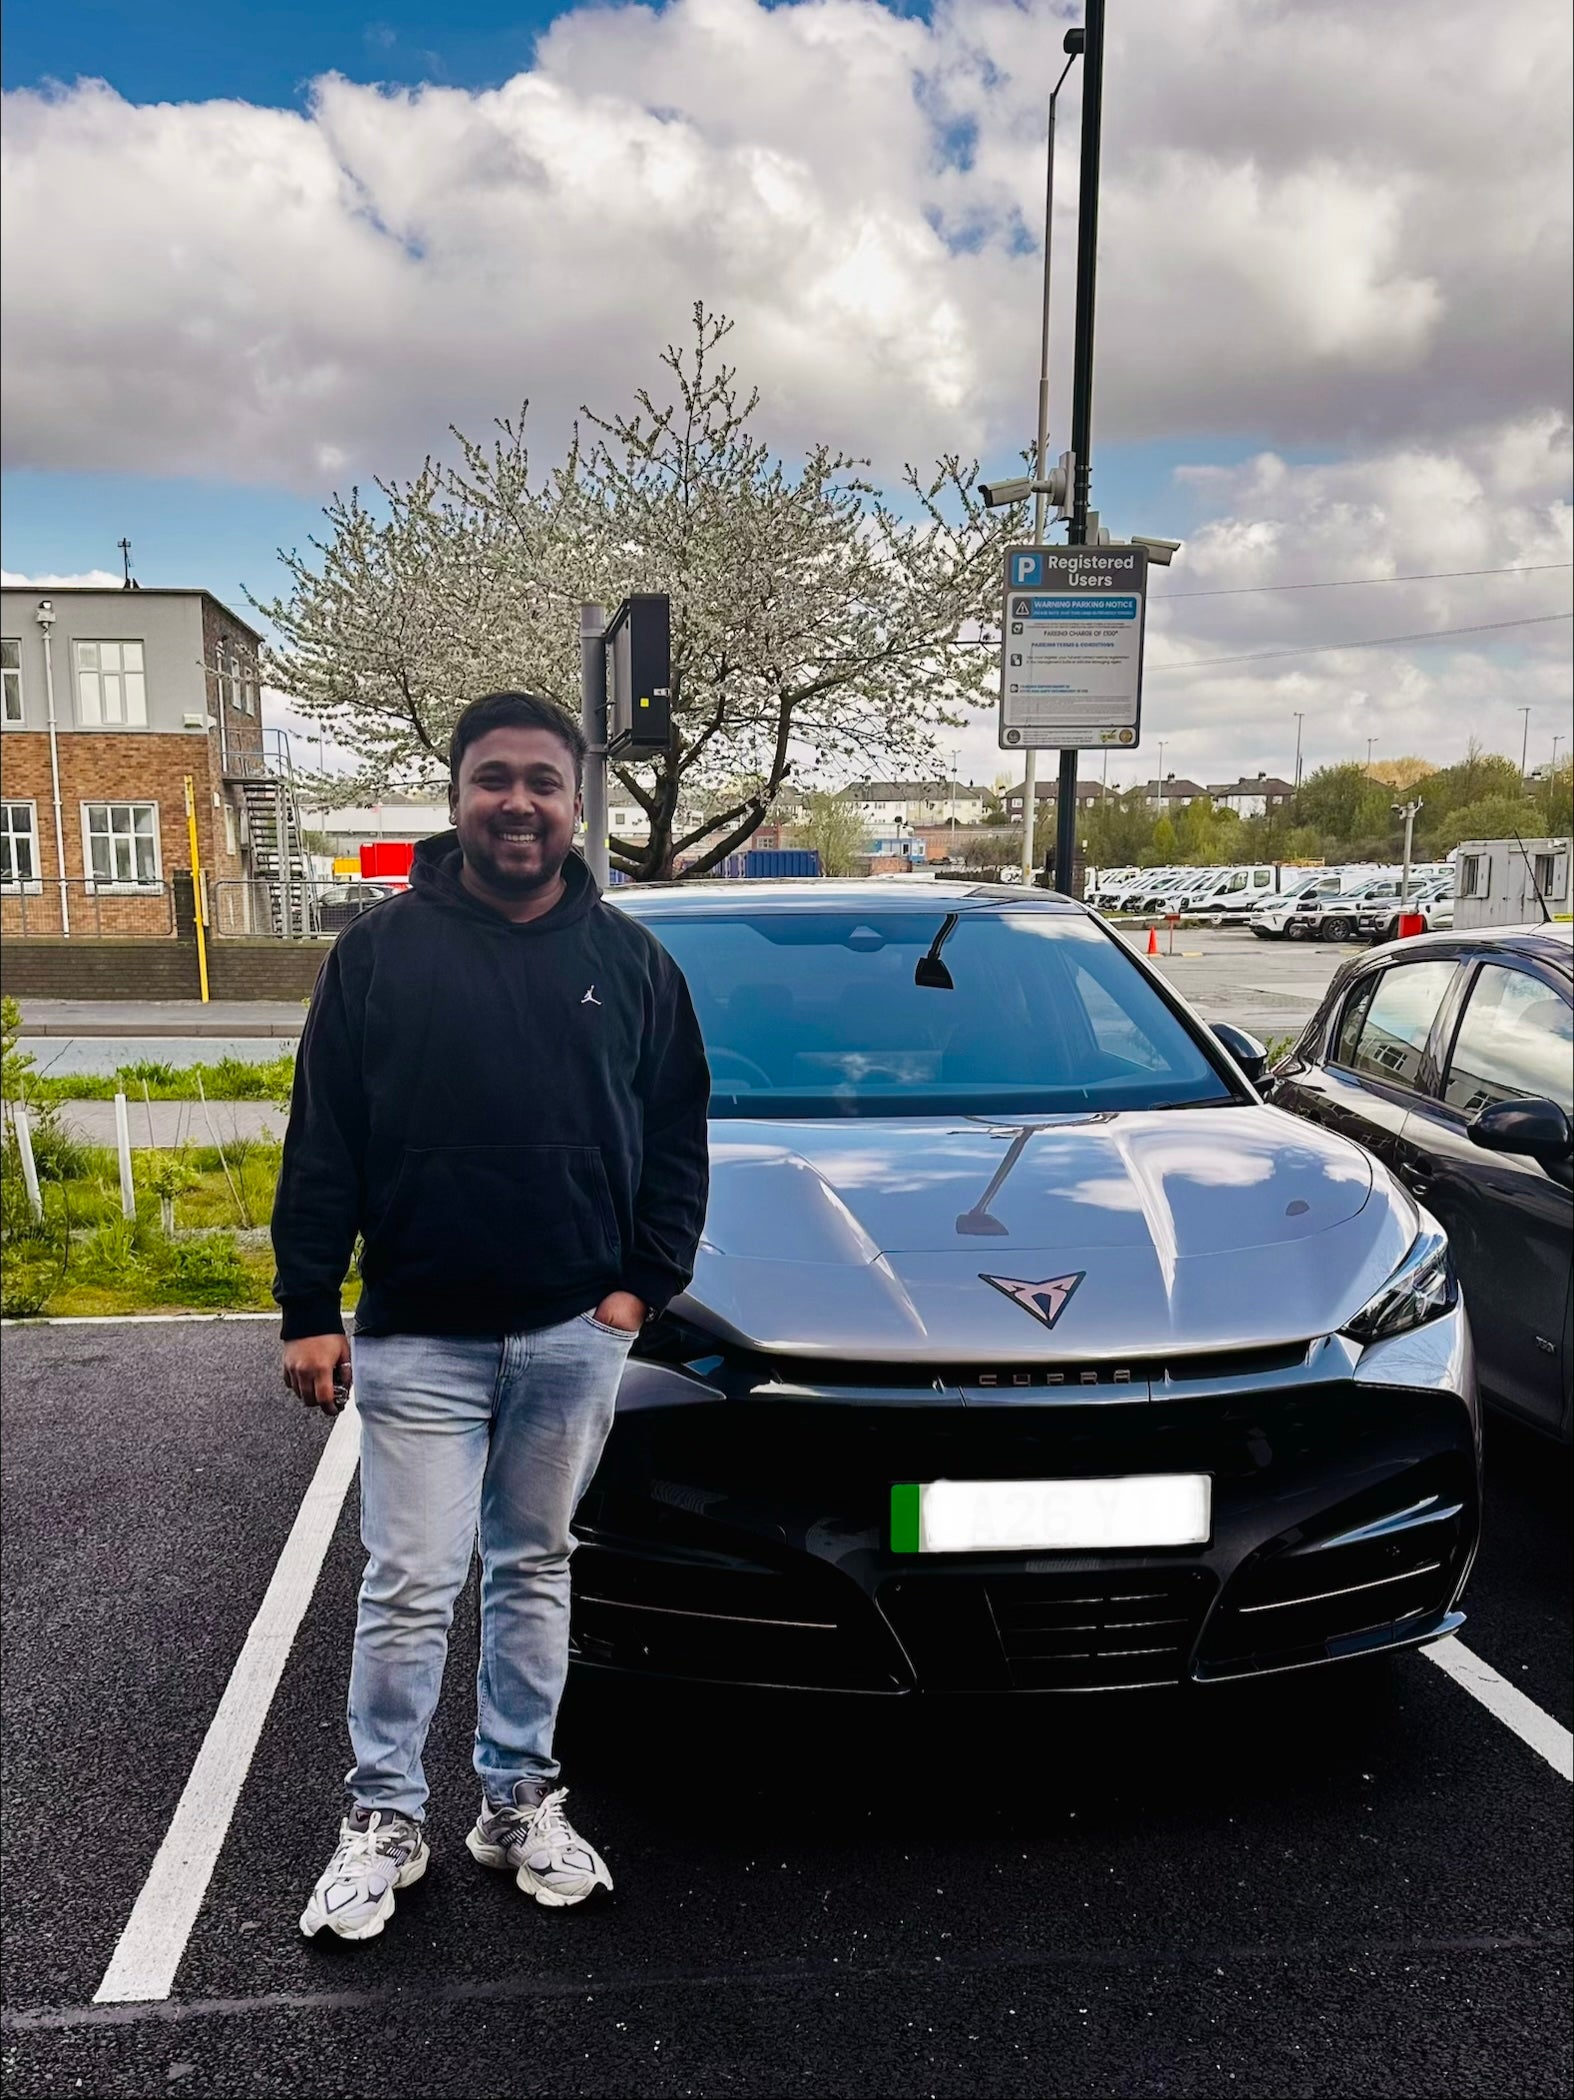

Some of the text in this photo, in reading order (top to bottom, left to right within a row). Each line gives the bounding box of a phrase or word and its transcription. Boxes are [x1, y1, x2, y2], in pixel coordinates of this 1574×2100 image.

[1018, 557, 1036, 582] P
[1048, 555, 1134, 573] Registered
[1068, 573, 1113, 587] Users
[979, 1369, 1131, 1386] CUPRA
